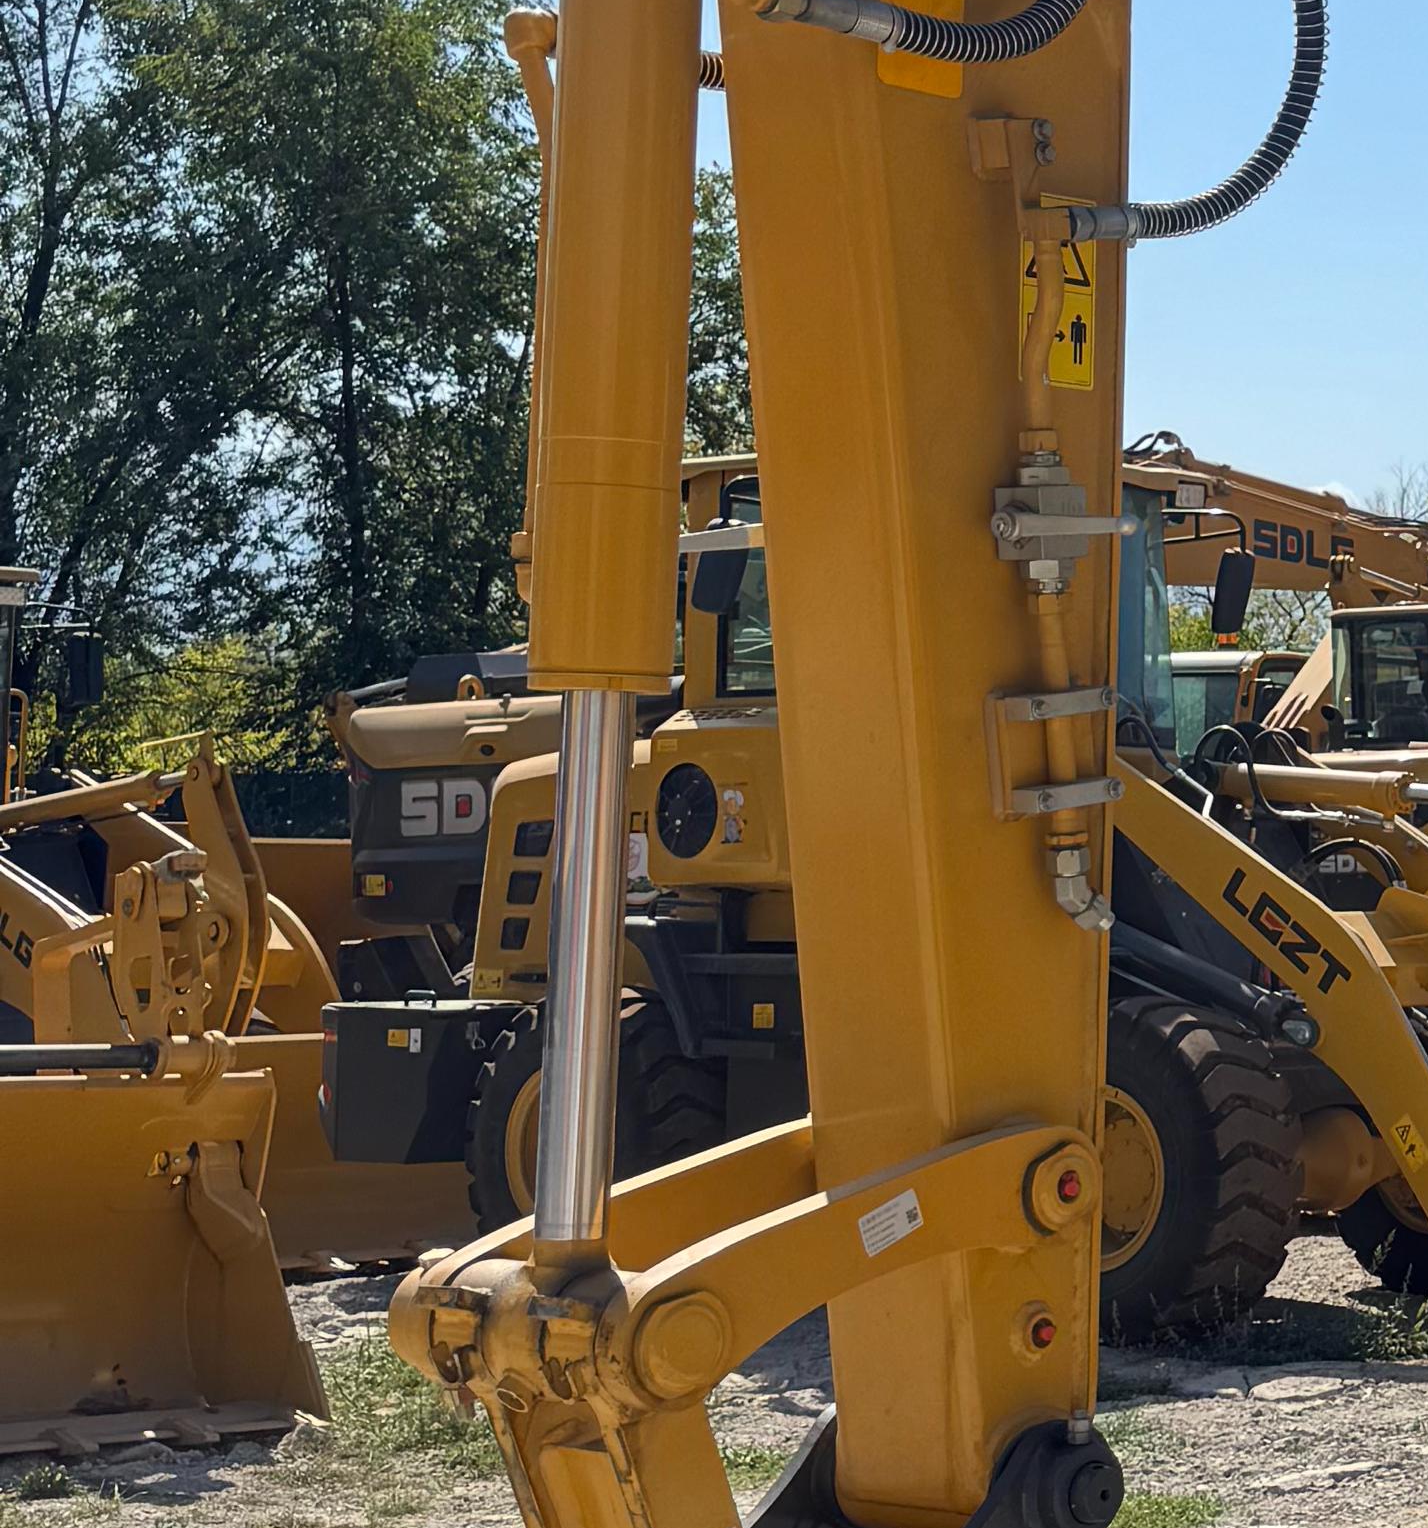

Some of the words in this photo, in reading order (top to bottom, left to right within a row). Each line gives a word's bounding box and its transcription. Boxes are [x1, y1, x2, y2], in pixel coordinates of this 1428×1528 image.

[400, 779, 487, 838] SD
[0, 911, 35, 969] LG
[1221, 866, 1352, 996] LGZT
